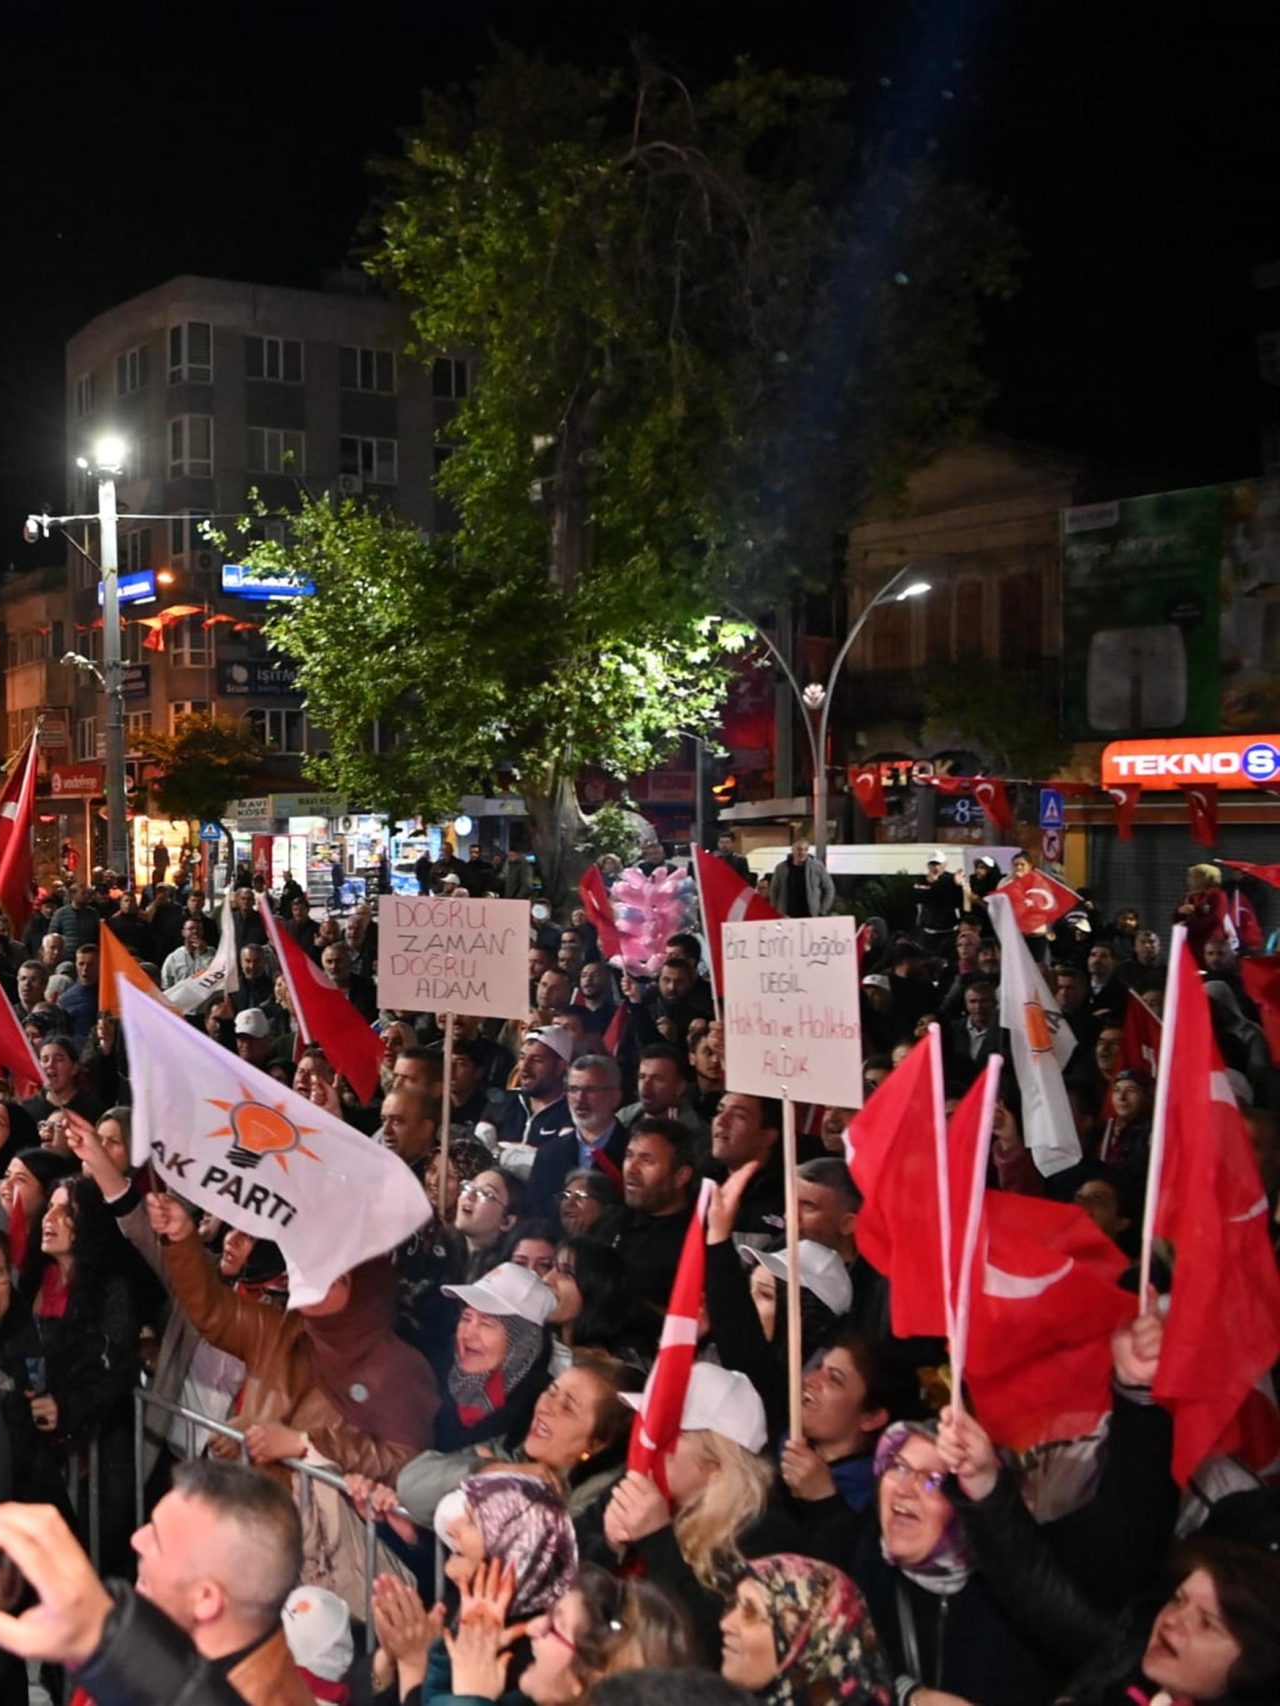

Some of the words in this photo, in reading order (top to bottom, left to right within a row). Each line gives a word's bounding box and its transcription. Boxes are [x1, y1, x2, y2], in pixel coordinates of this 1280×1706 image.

[1111, 749, 1280, 776] TEKNOS
[395, 898, 488, 929] DOĞRU
[397, 928, 516, 956] ZAMAN
[390, 953, 477, 979] DOĞRU
[415, 977, 490, 1002] ADAM
[149, 1140, 195, 1178] AK
